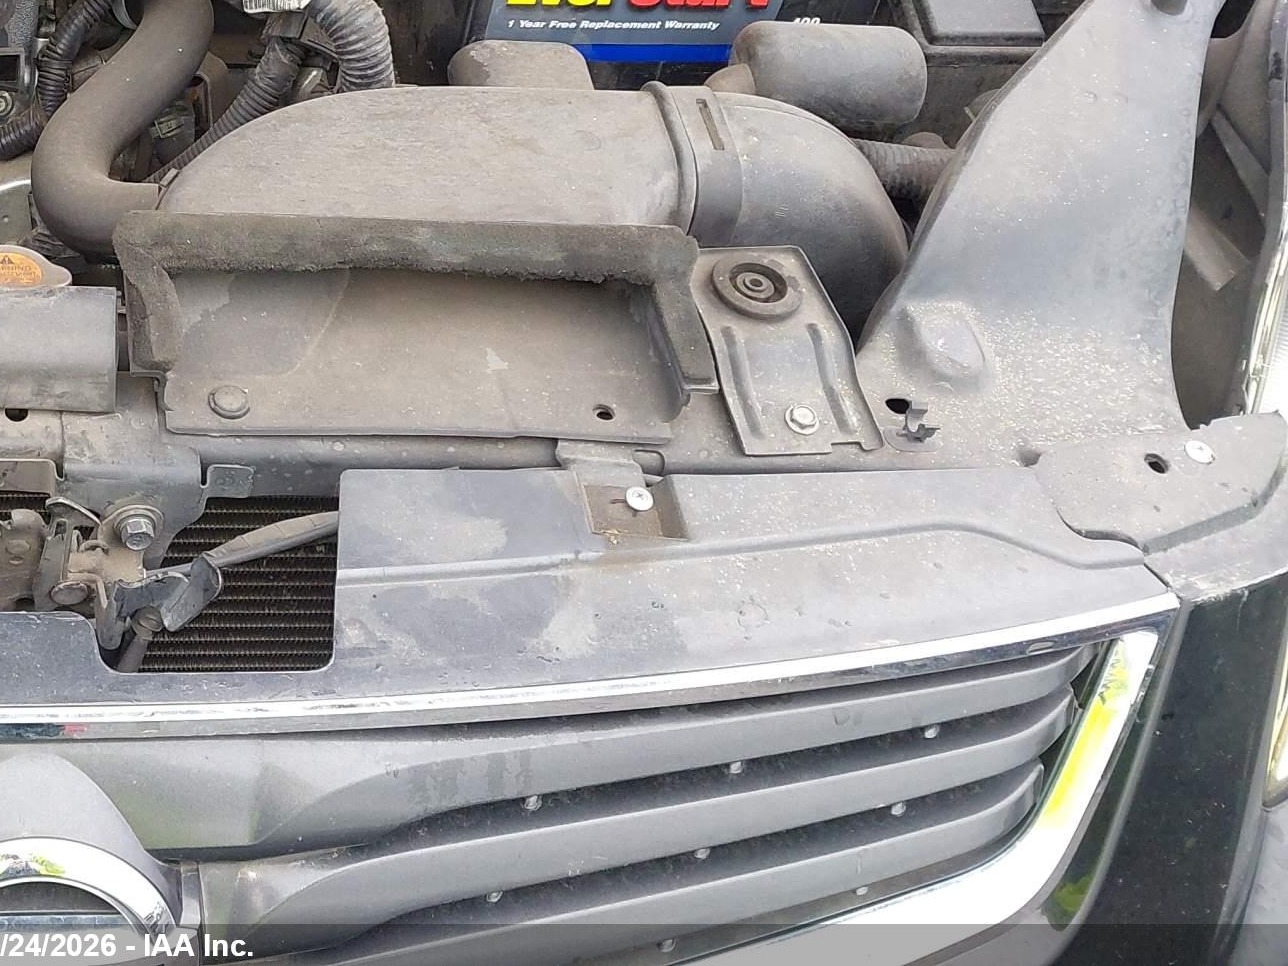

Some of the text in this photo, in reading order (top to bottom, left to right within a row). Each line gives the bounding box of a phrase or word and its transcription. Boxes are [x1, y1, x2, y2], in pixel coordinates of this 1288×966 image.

[507, 20, 721, 31] 1 Year Free Replacement Warranty
